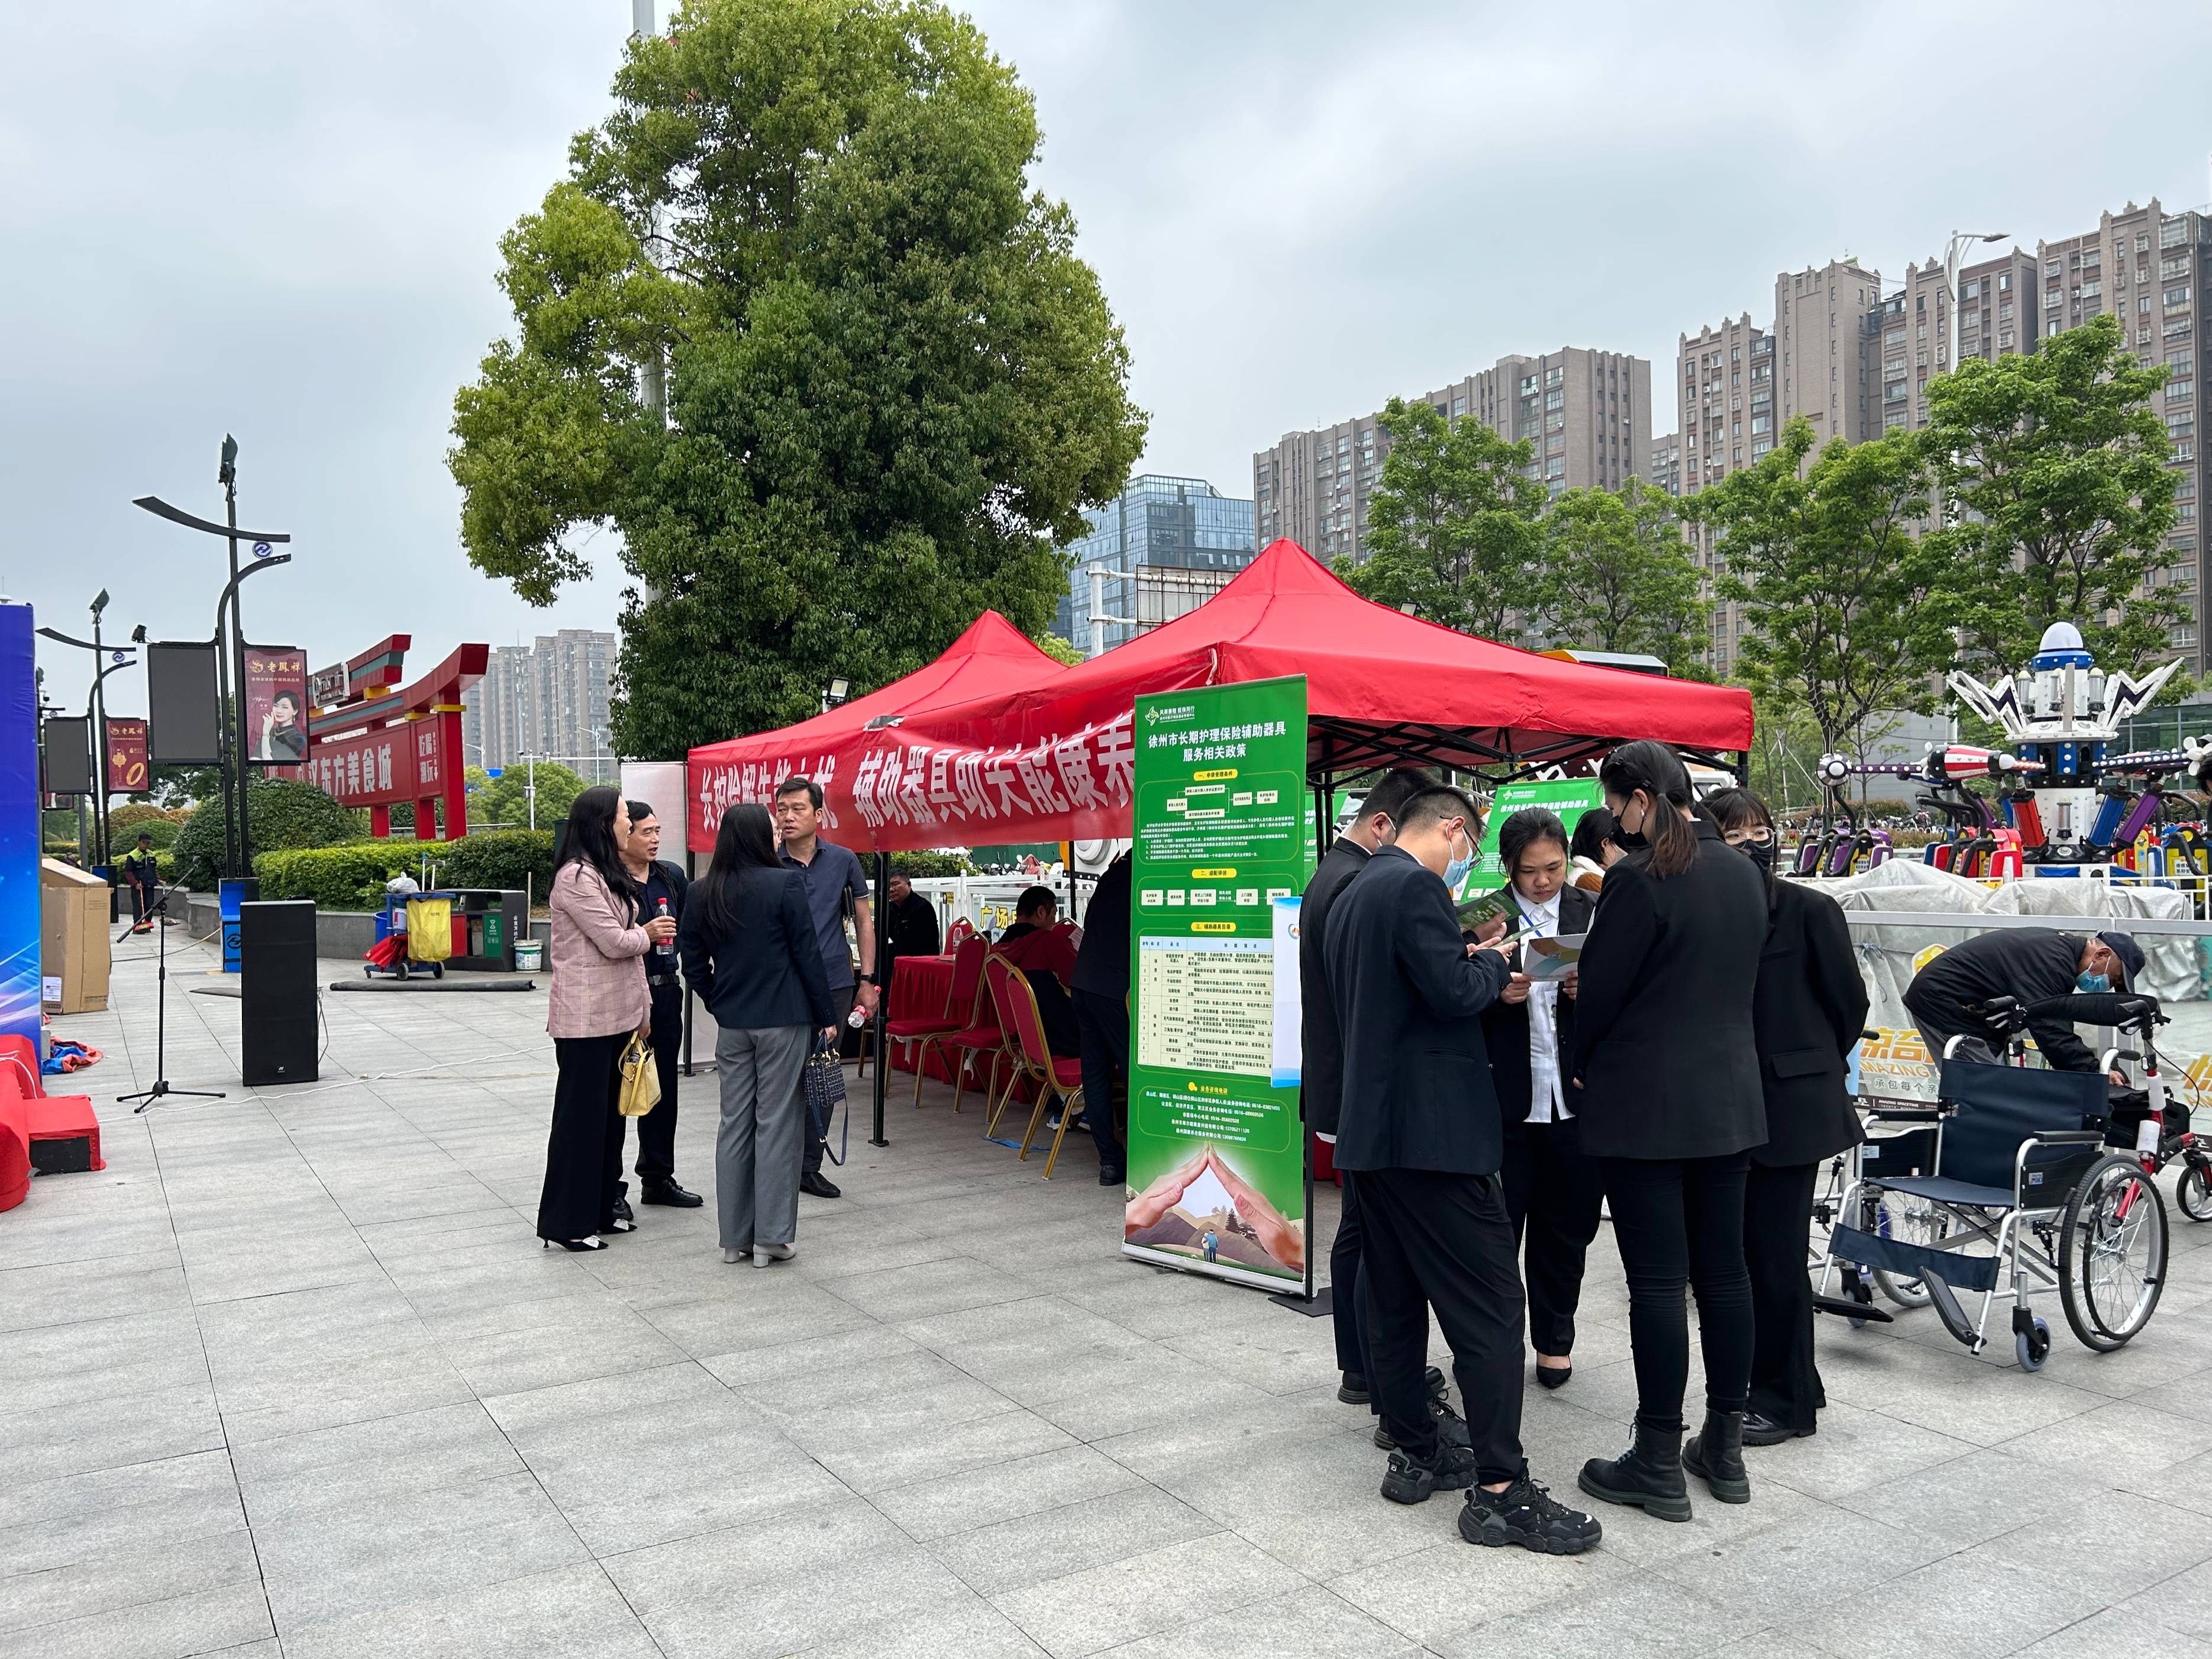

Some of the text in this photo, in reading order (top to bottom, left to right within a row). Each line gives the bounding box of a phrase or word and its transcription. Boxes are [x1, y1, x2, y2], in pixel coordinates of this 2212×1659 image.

[267, 661, 301, 673] 老鳳祥
[1148, 721, 1287, 749] 徐州市长期护理保险辅助器具
[1183, 743, 1247, 763] 服务相关政策
